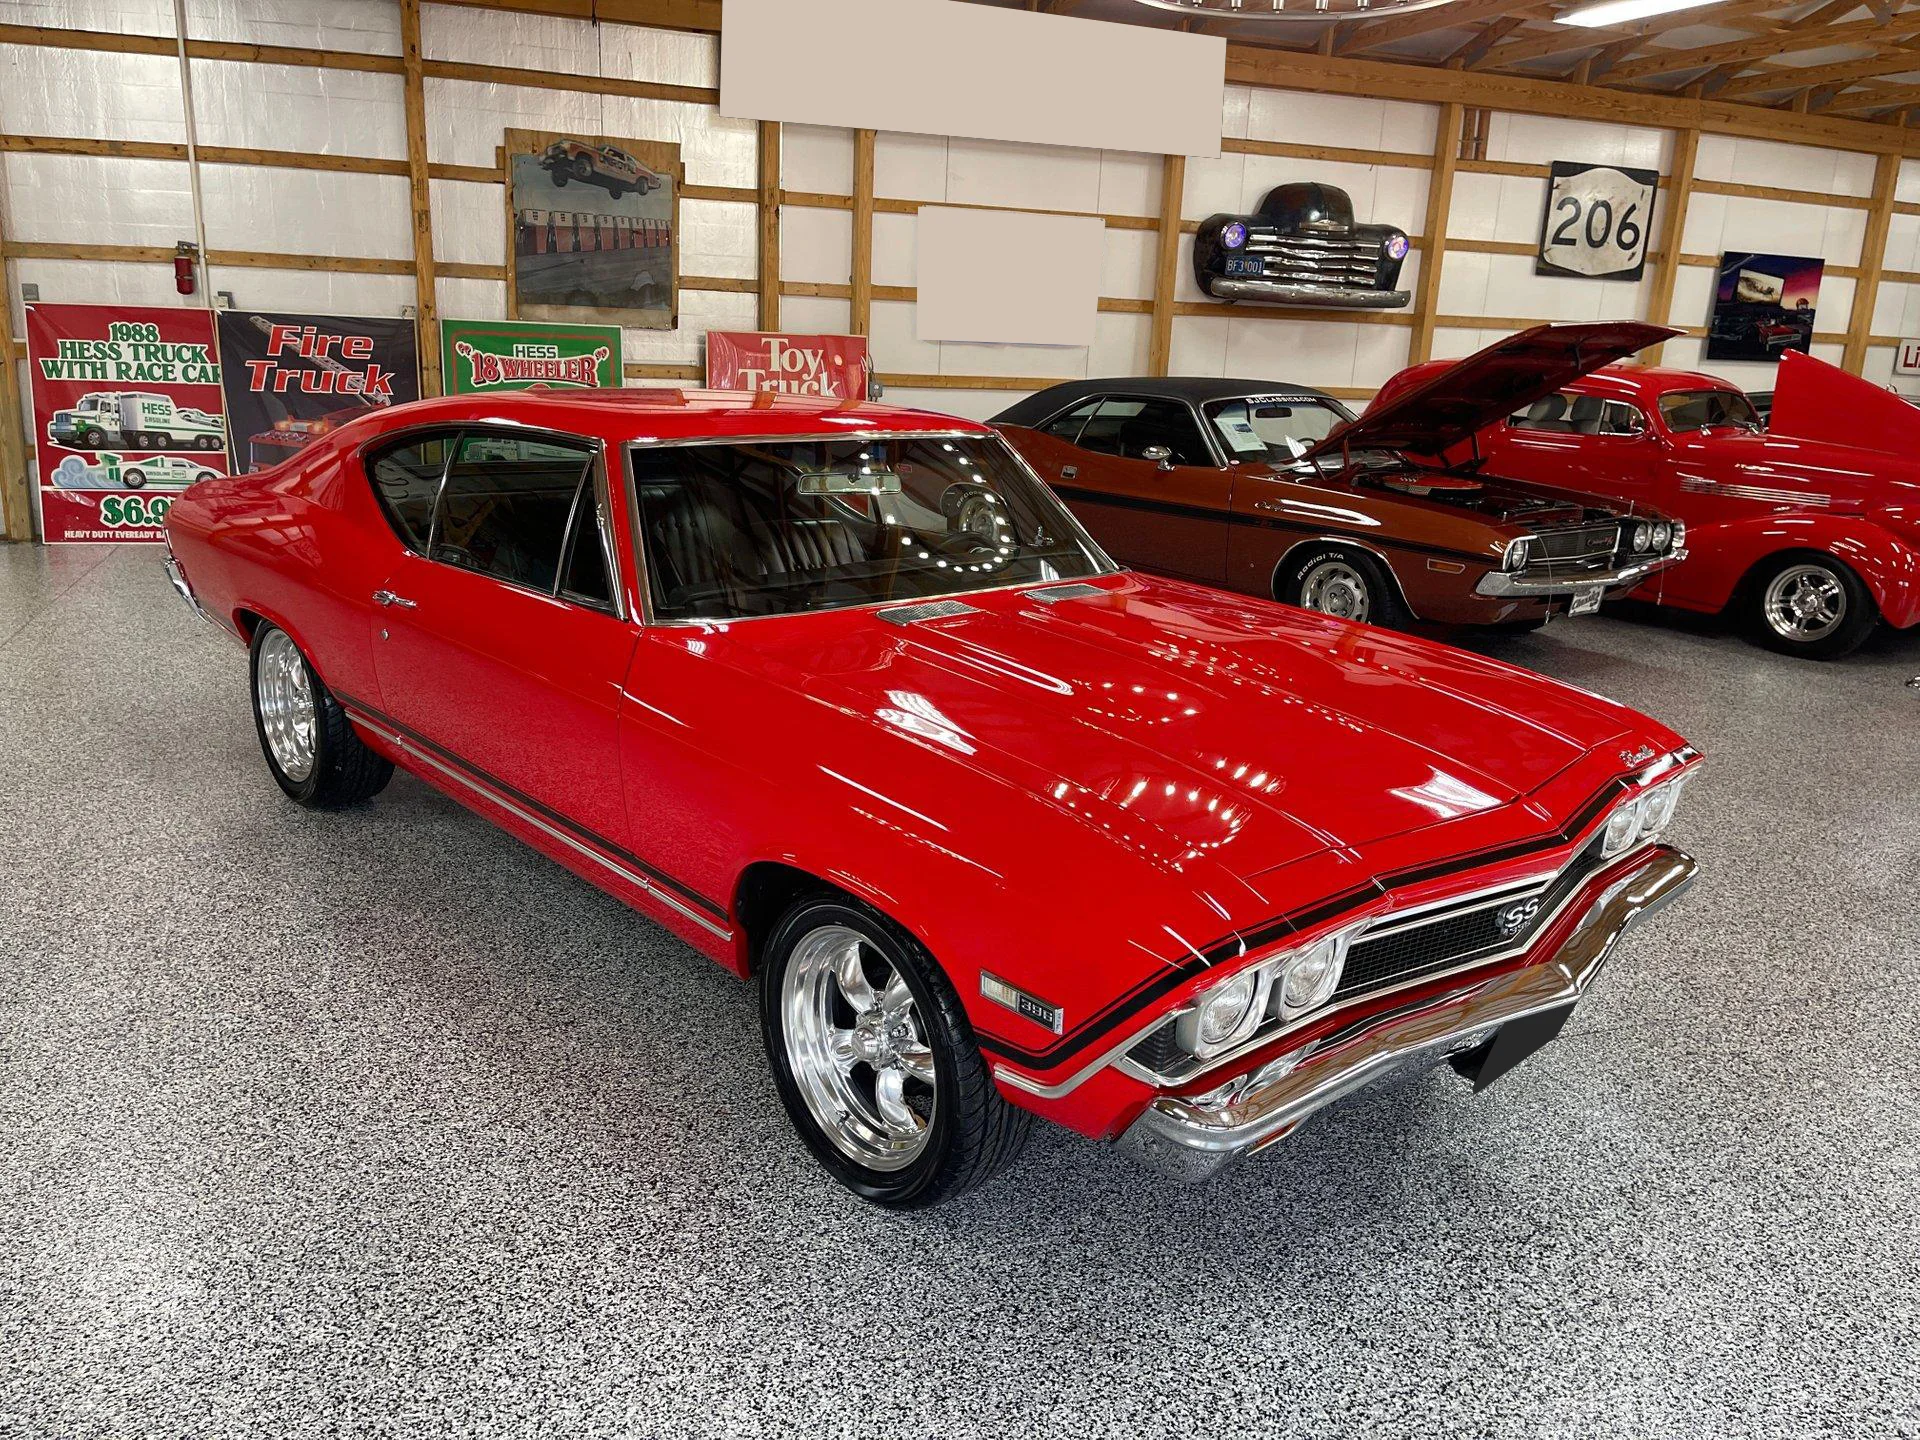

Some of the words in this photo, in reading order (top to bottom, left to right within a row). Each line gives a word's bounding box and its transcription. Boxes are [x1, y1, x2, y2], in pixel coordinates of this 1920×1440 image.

[1551, 196, 1640, 251] 206
[109, 323, 159, 343] 1988
[266, 324, 374, 360] Fire
[59, 340, 123, 361] HESS
[127, 343, 208, 363] TRUCK
[515, 345, 557, 359] HESS
[761, 337, 825, 381] Toy
[40, 359, 108, 380] WITH
[115, 361, 174, 382] RACE
[245, 359, 396, 396] Truck
[141, 402, 172, 416] HESS
[102, 496, 172, 525] $6.9
[64, 530, 91, 539] HEAVY
[92, 530, 114, 539] DUTY
[115, 530, 155, 539] EVEREADY
[1296, 553, 1326, 581] Radial
[1328, 552, 1344, 560] T/A
[1505, 897, 1539, 928] SS
[1021, 998, 1053, 1022] 396
